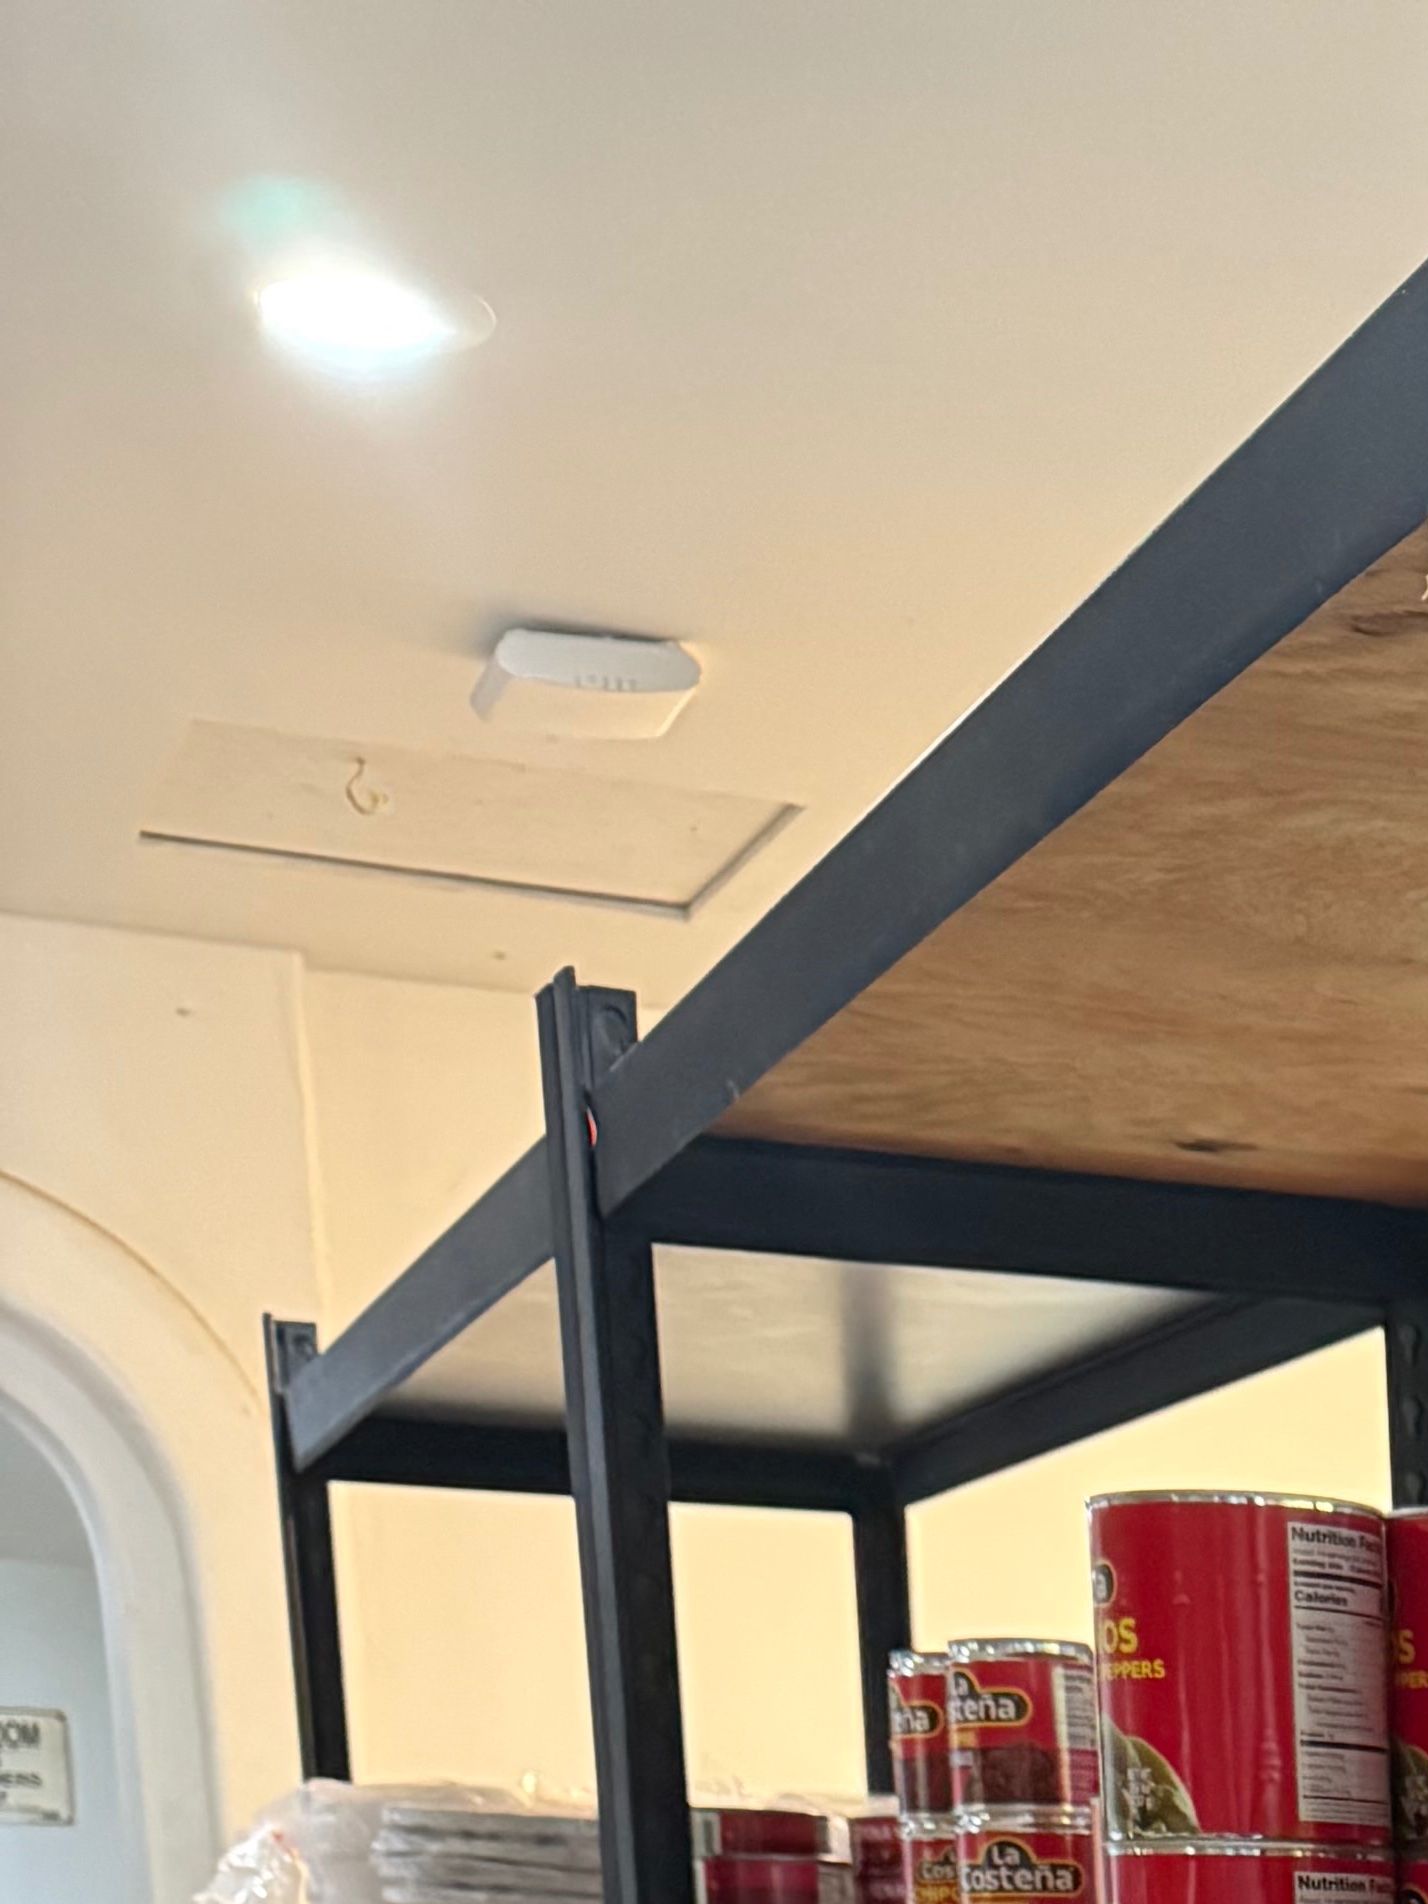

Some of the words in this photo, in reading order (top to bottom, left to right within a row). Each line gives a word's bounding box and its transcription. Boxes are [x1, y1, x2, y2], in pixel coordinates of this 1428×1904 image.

[1290, 1523, 1357, 1551] Nutrition
[1293, 1588, 1350, 1609] Calories
[992, 1847, 1020, 1868] La
[1296, 1873, 1367, 1895] Nutrition
